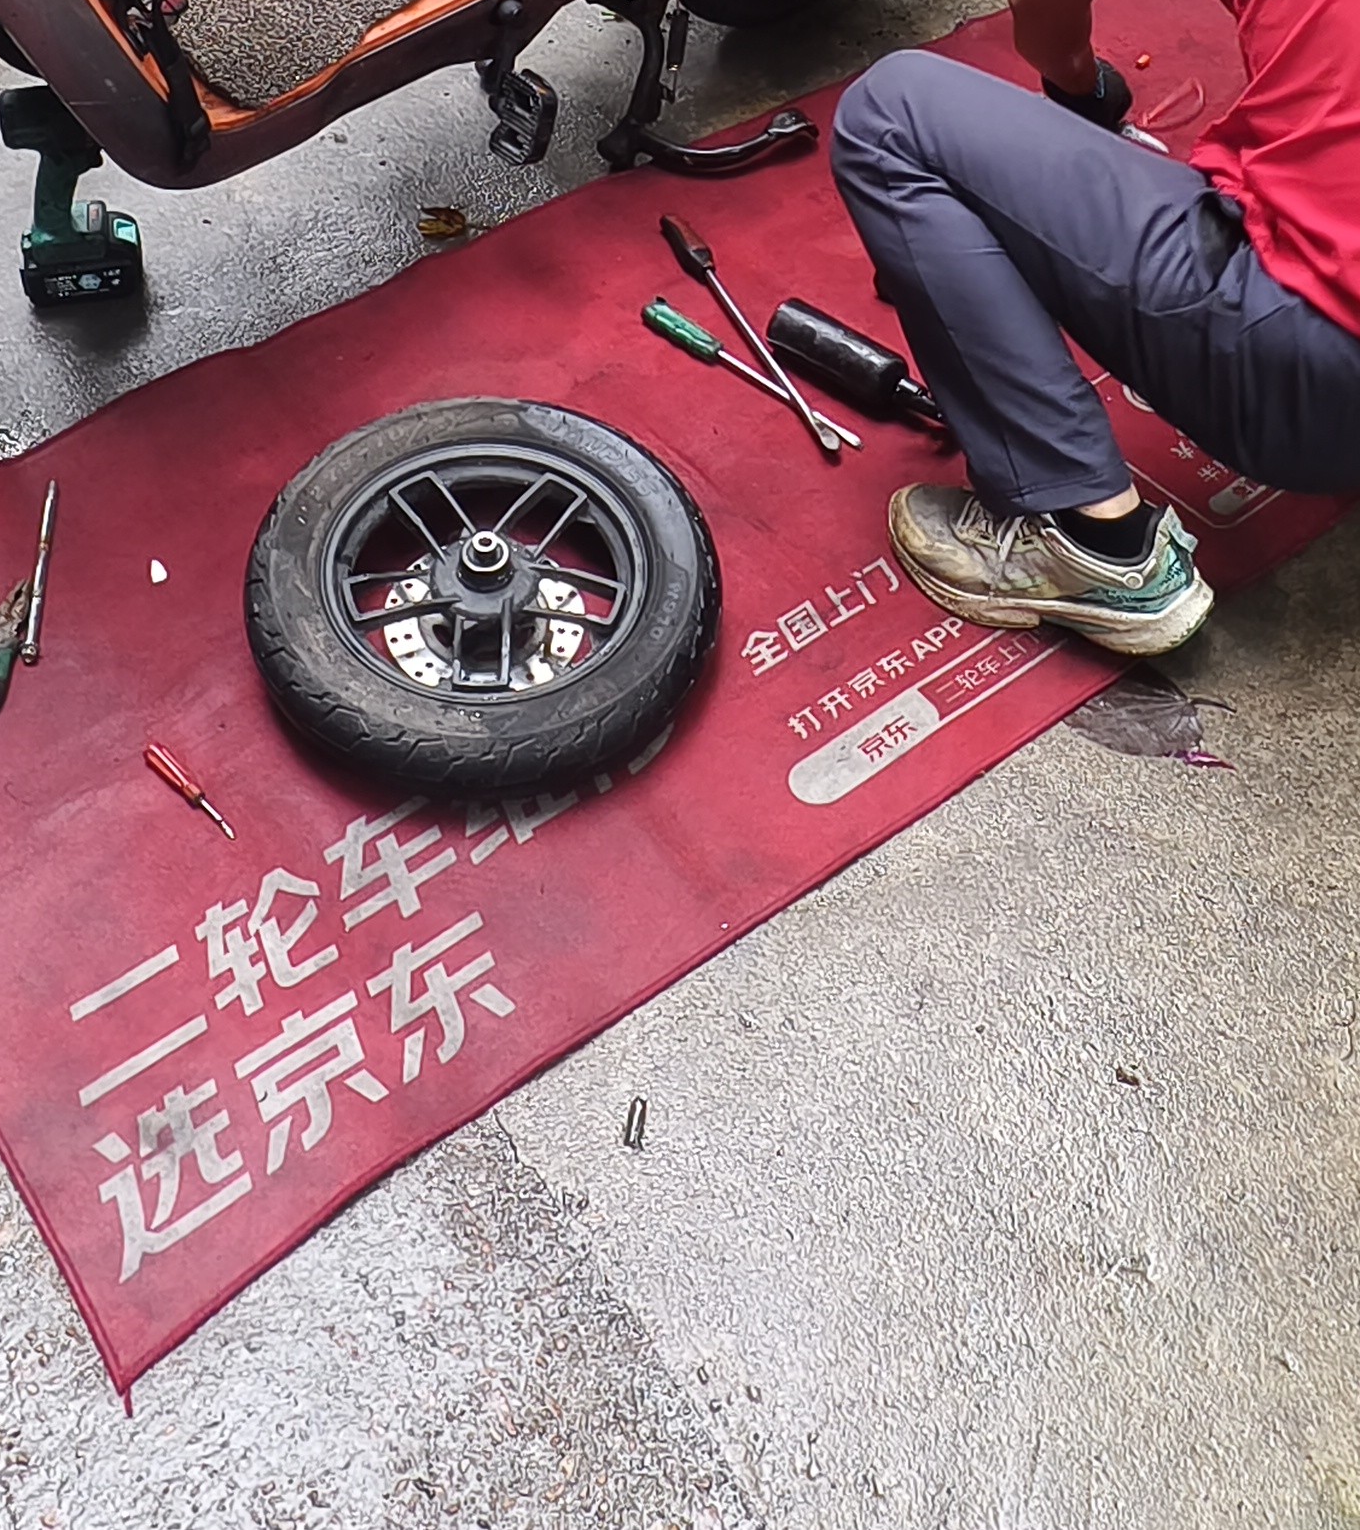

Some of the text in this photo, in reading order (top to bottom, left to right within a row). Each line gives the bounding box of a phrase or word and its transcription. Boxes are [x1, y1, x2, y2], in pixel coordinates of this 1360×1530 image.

[70, 728, 672, 1108] 二轮车
[857, 715, 918, 763] 京东
[92, 912, 516, 1283] 选京东
